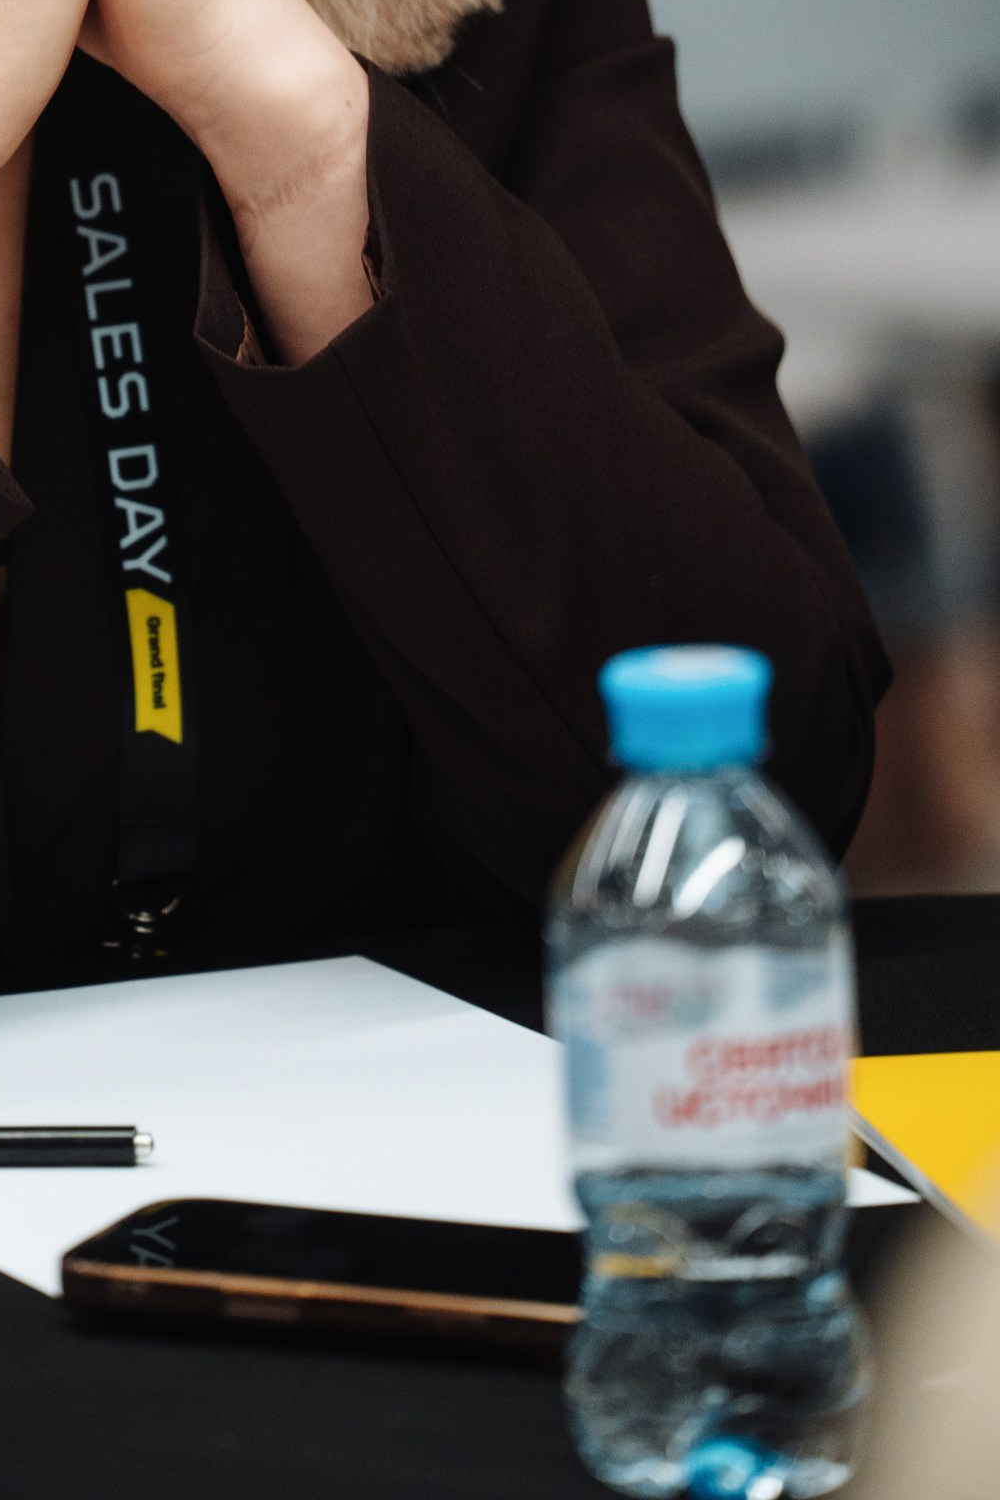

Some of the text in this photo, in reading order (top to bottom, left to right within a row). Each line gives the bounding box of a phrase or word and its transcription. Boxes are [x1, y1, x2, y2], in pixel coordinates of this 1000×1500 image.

[69, 172, 173, 585] SALES DAY
[146, 614, 165, 669] Grand
